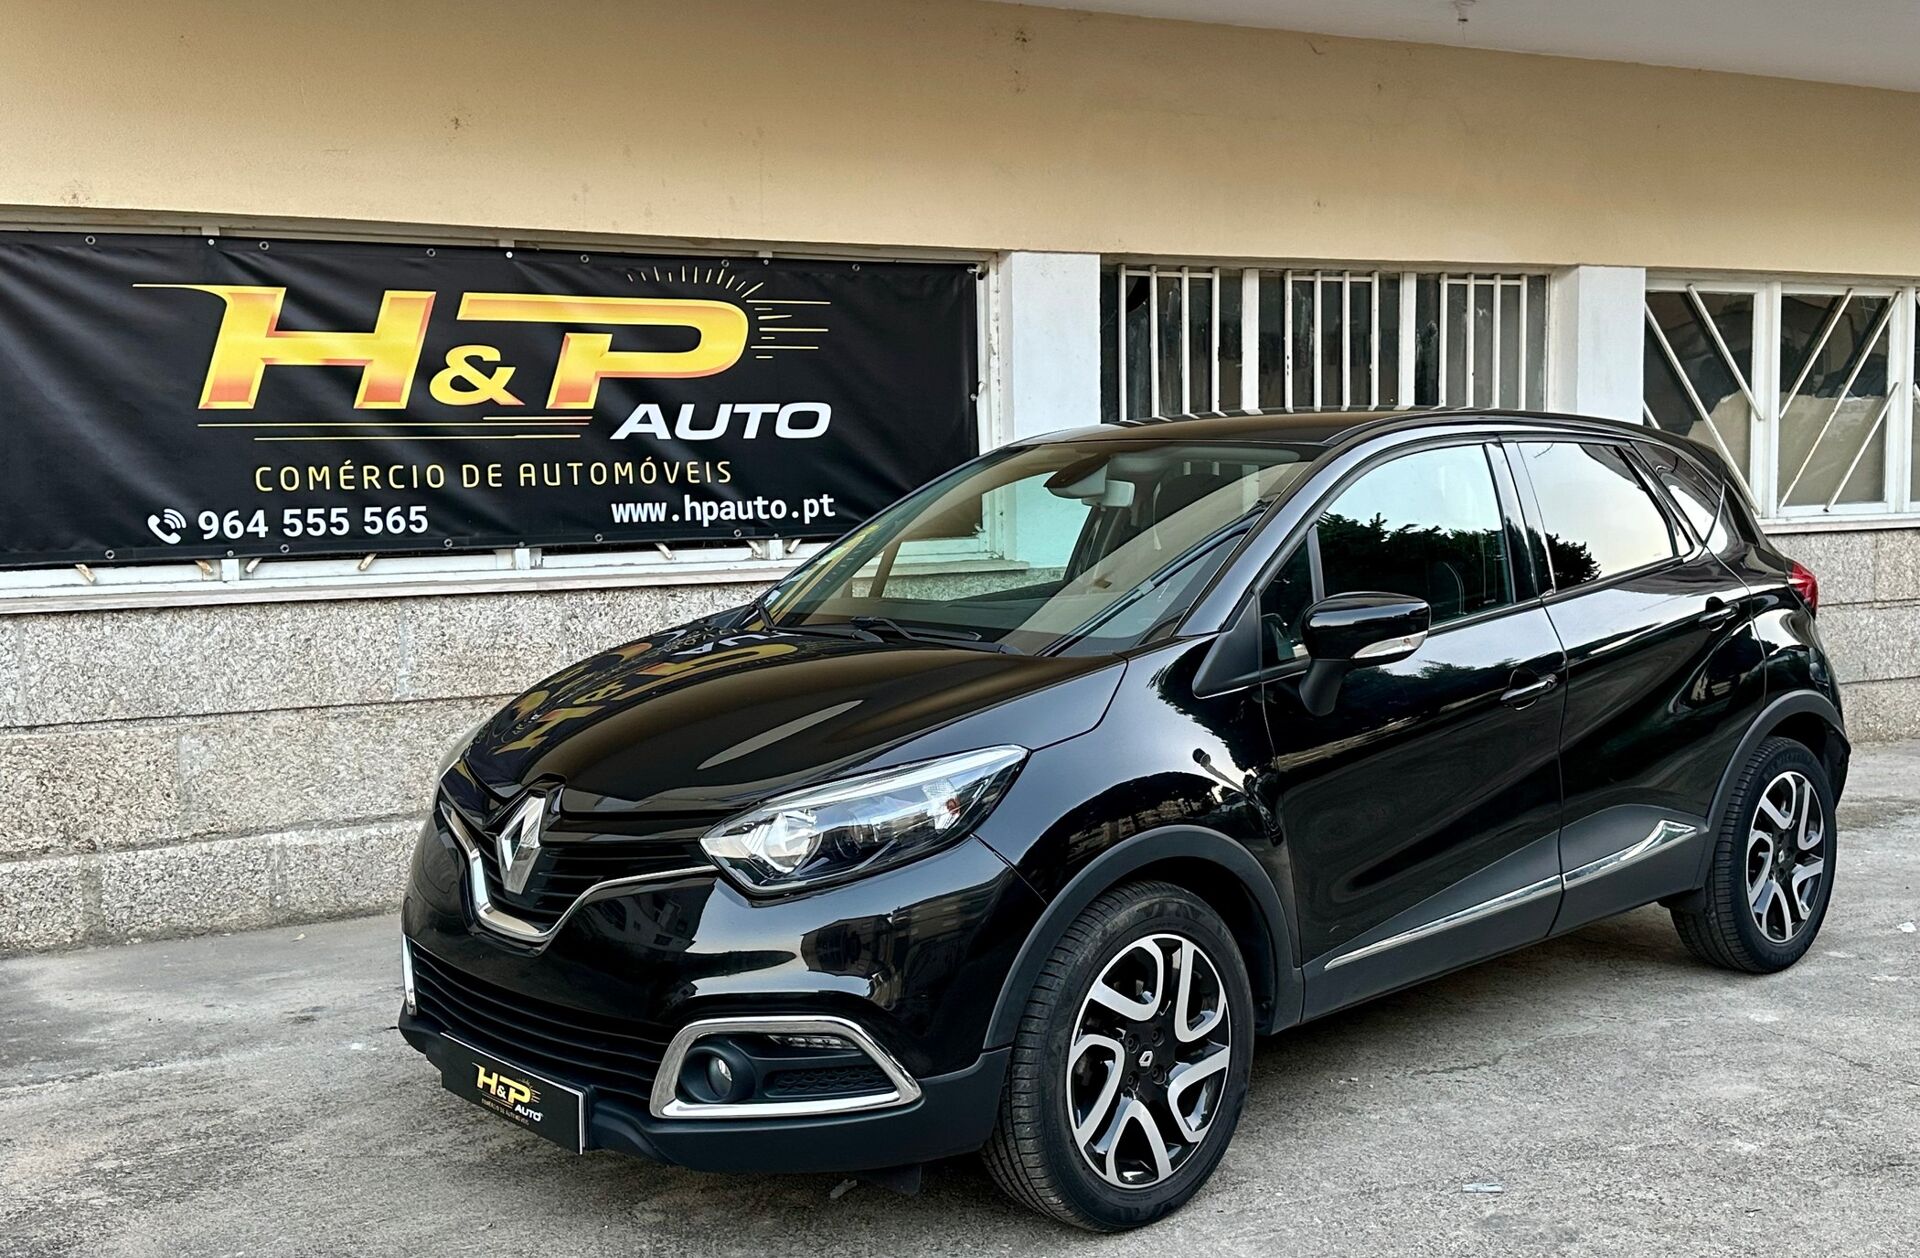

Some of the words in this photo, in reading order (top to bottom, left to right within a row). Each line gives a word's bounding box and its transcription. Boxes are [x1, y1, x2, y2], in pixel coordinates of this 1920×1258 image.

[609, 402, 832, 440] AUTO
[254, 459, 446, 492] COMÉRCIO
[461, 463, 503, 488] DE
[518, 456, 732, 487] AUTOMÓVEIS
[197, 508, 270, 540] 964
[282, 506, 351, 538] 555
[362, 504, 429, 535] 565
[610, 493, 836, 528] www.hpauto.pt
[513, 1104, 543, 1122] AUTO
